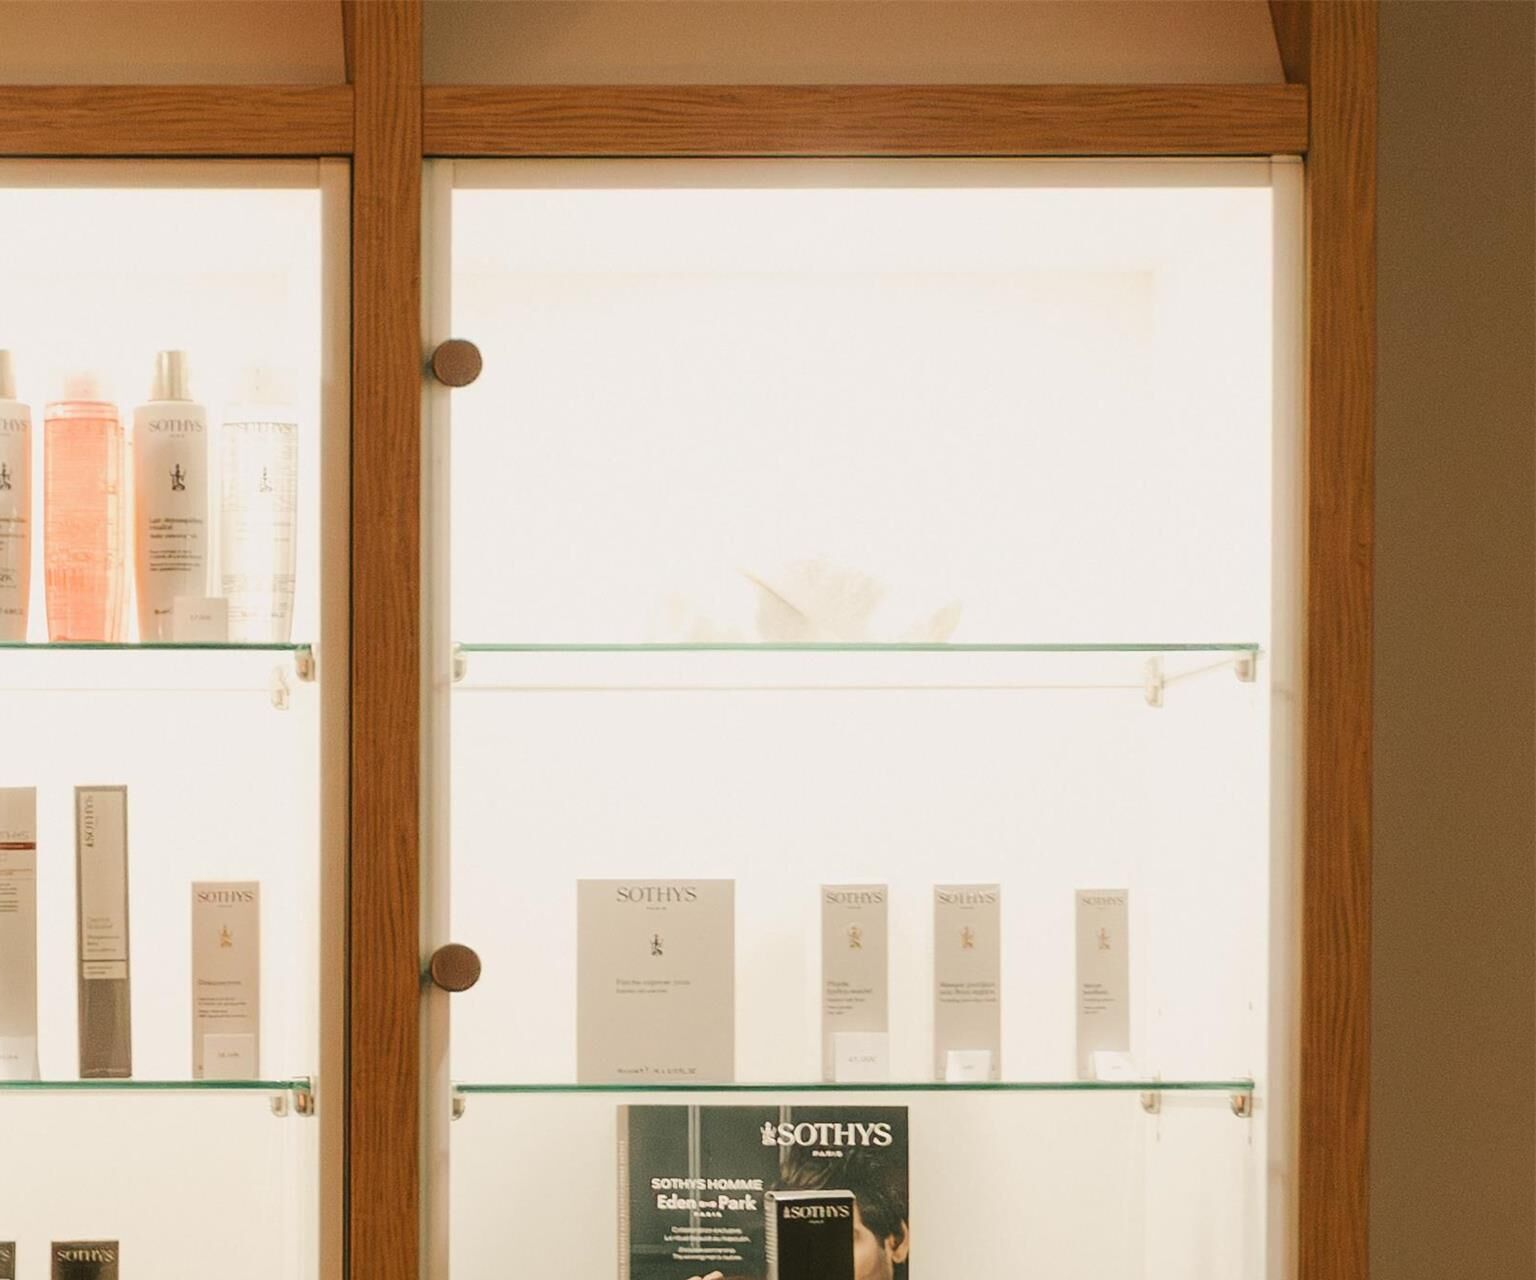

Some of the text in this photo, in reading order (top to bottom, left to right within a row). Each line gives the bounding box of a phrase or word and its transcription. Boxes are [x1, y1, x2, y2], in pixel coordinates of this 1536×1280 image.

[149, 419, 203, 433] SOTHYS
[197, 890, 254, 903] SOTHYS
[616, 886, 697, 903] SOTHYS
[826, 891, 883, 905] SOTHYS
[938, 892, 996, 905] SOTHYS
[1082, 895, 1124, 907] SOTHYS
[777, 1122, 893, 1147] SOTHYS
[651, 1178, 764, 1191] SOTHYS HOMME
[657, 1194, 758, 1210] Eden Park
[791, 1205, 850, 1219] SOTHYS
[57, 1249, 115, 1263] SOTHYS
